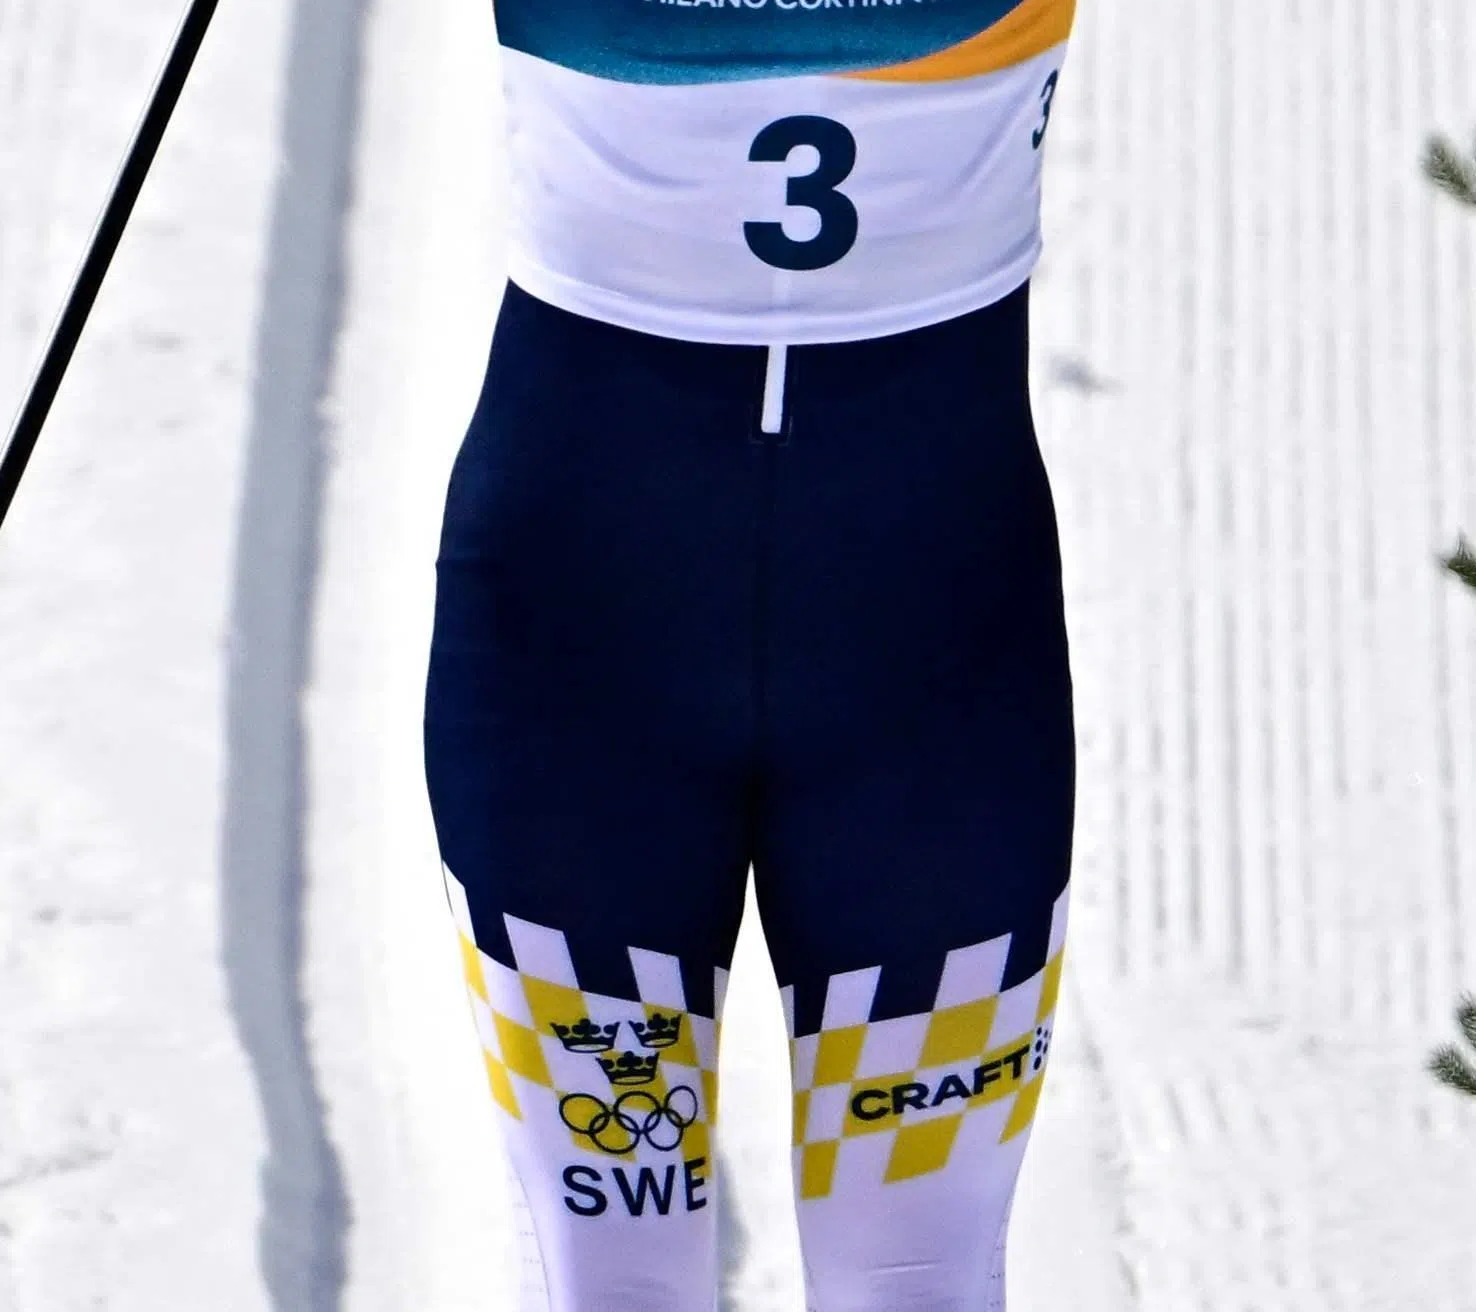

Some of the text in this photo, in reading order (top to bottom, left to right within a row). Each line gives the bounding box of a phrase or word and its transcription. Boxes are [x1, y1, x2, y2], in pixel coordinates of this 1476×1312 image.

[1031, 69, 1058, 151] 3
[743, 115, 859, 271] 3
[851, 1044, 1030, 1122] CRAFT
[561, 1156, 708, 1217] SWE
